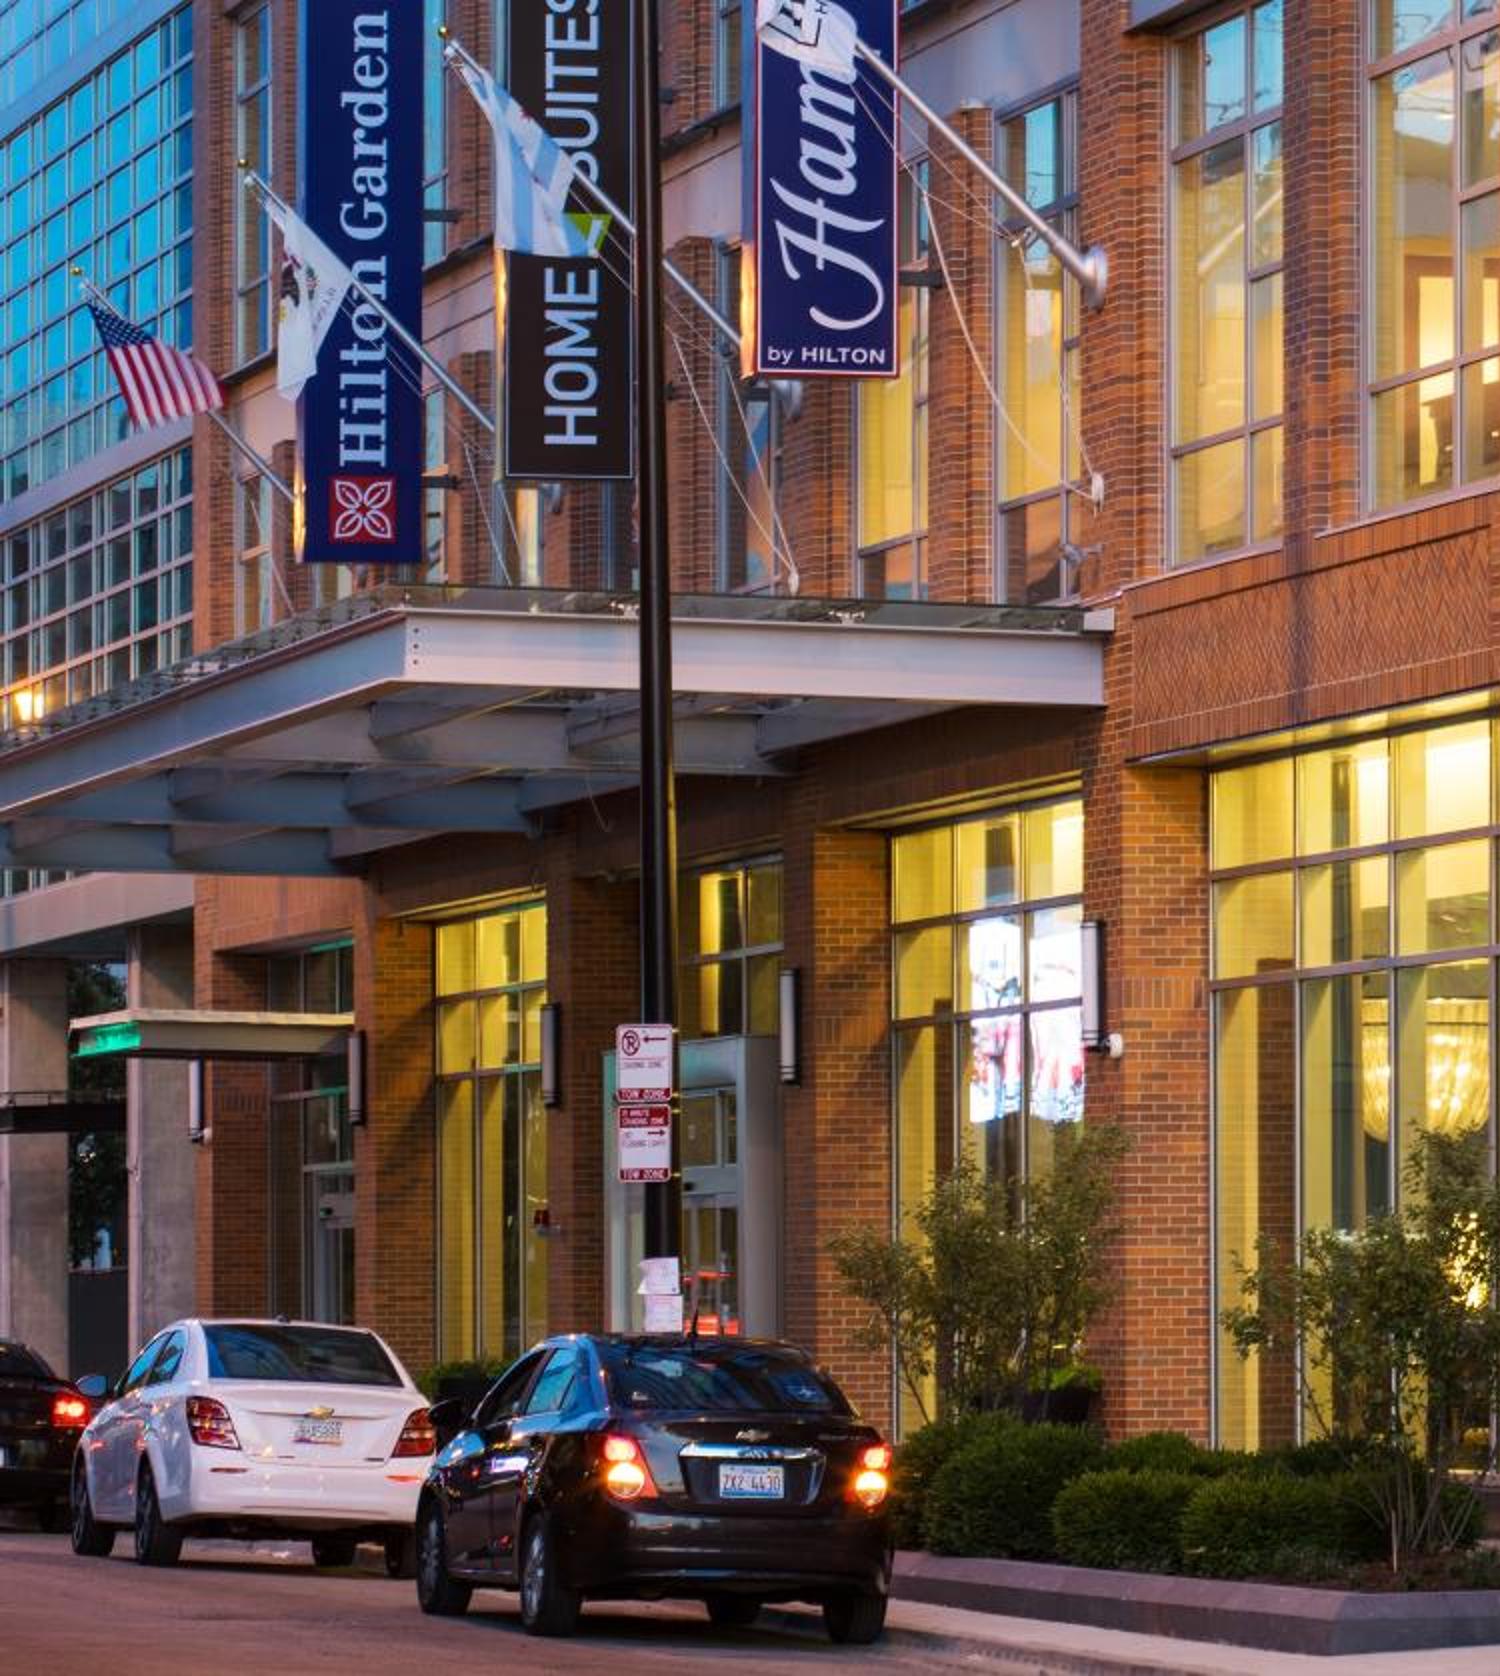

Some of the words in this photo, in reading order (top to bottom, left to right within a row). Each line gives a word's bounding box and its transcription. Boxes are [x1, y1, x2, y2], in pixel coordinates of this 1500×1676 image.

[340, 10, 389, 241] Garden
[339, 255, 388, 468] Hilton
[767, 345, 795, 365] by
[801, 346, 886, 365] HILTON
